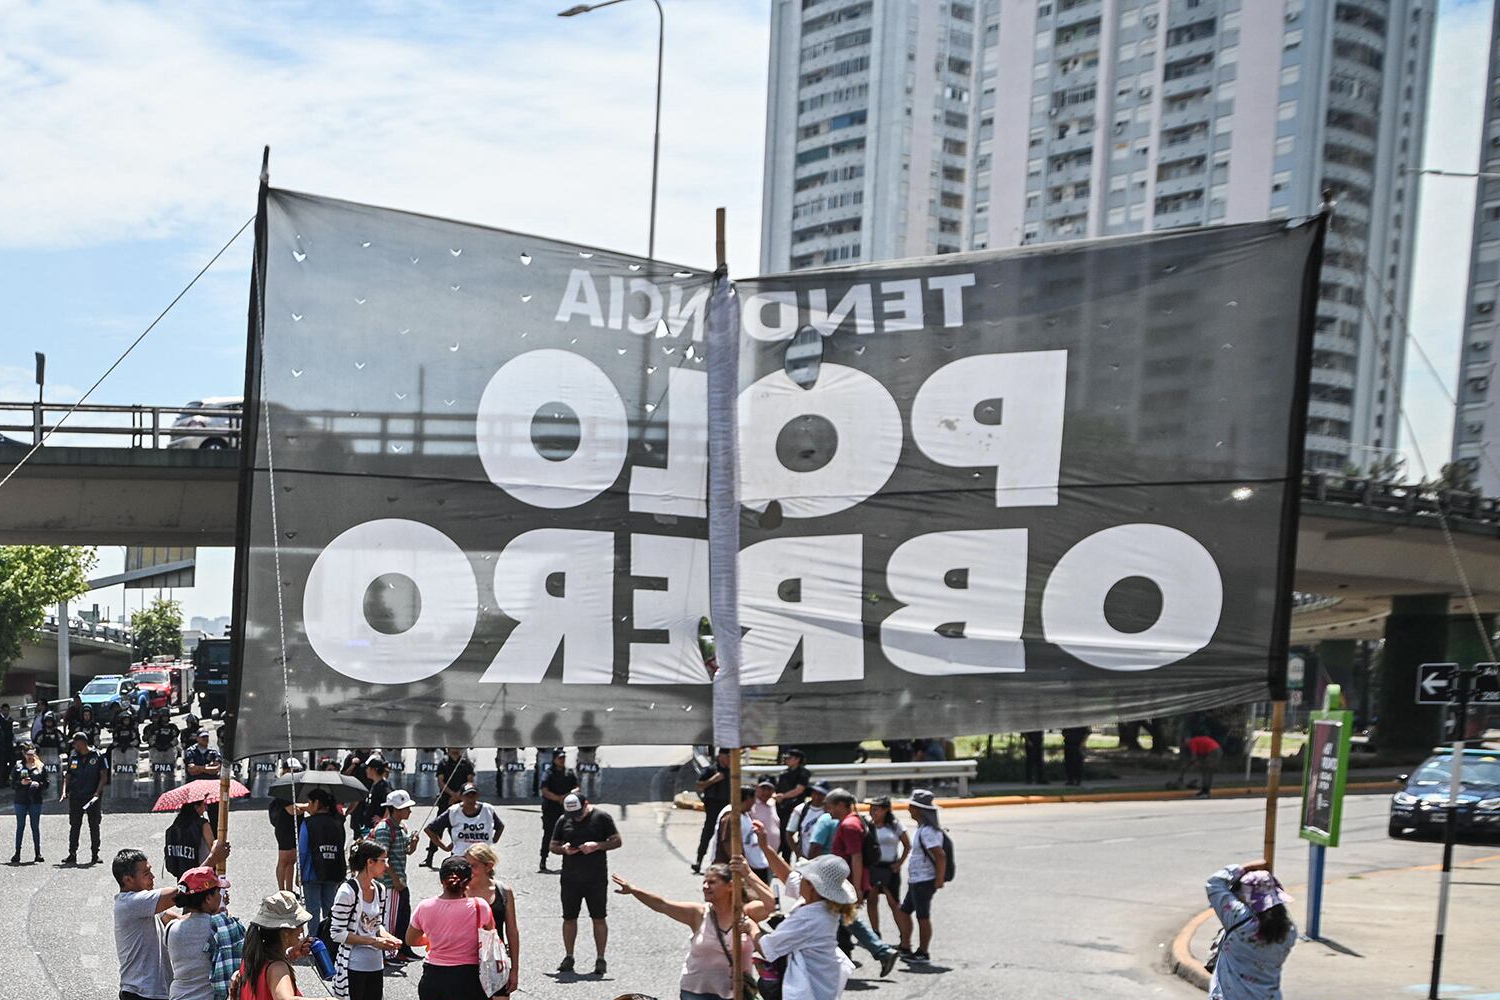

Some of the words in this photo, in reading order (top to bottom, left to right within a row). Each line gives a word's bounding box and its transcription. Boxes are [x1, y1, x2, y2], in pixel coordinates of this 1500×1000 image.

[116, 765, 134, 773] PNA
[154, 764, 171, 772] PNA
[256, 764, 273, 772] PNA
[463, 823, 484, 831] POLO
